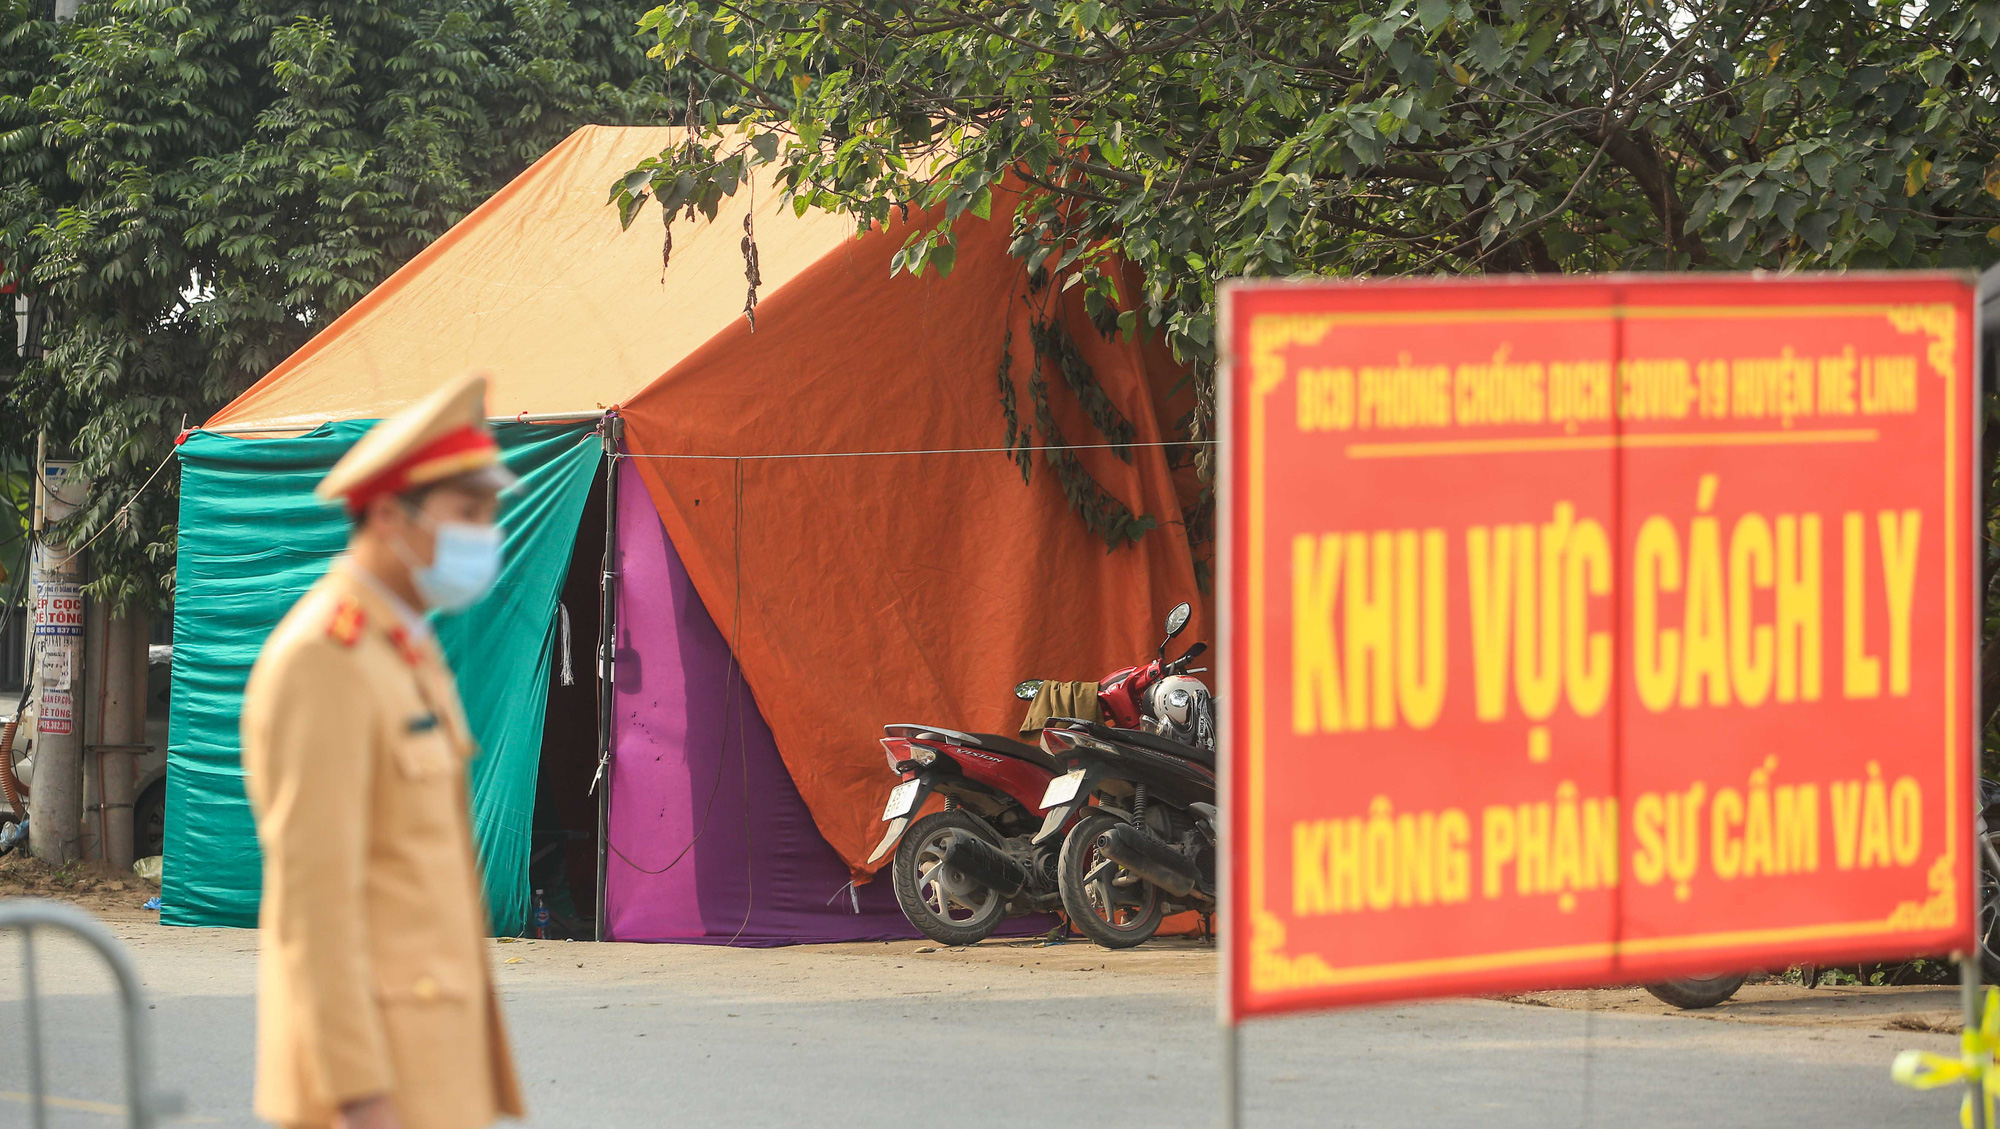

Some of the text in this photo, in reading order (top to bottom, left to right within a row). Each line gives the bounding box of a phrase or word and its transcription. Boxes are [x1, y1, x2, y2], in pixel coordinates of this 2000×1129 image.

[1550, 360, 1612, 435] DỊCH
[1615, 358, 1728, 421] COVID-19
[1860, 355, 1917, 415] LINH
[48, 610, 83, 624] TÔNG
[1292, 473, 1923, 763] KHU VỰC CÁCH LY
[956, 748, 1004, 763] VISION
[1293, 754, 1923, 917] KHÔNG PHẬN SỰ CẤM VÀO
